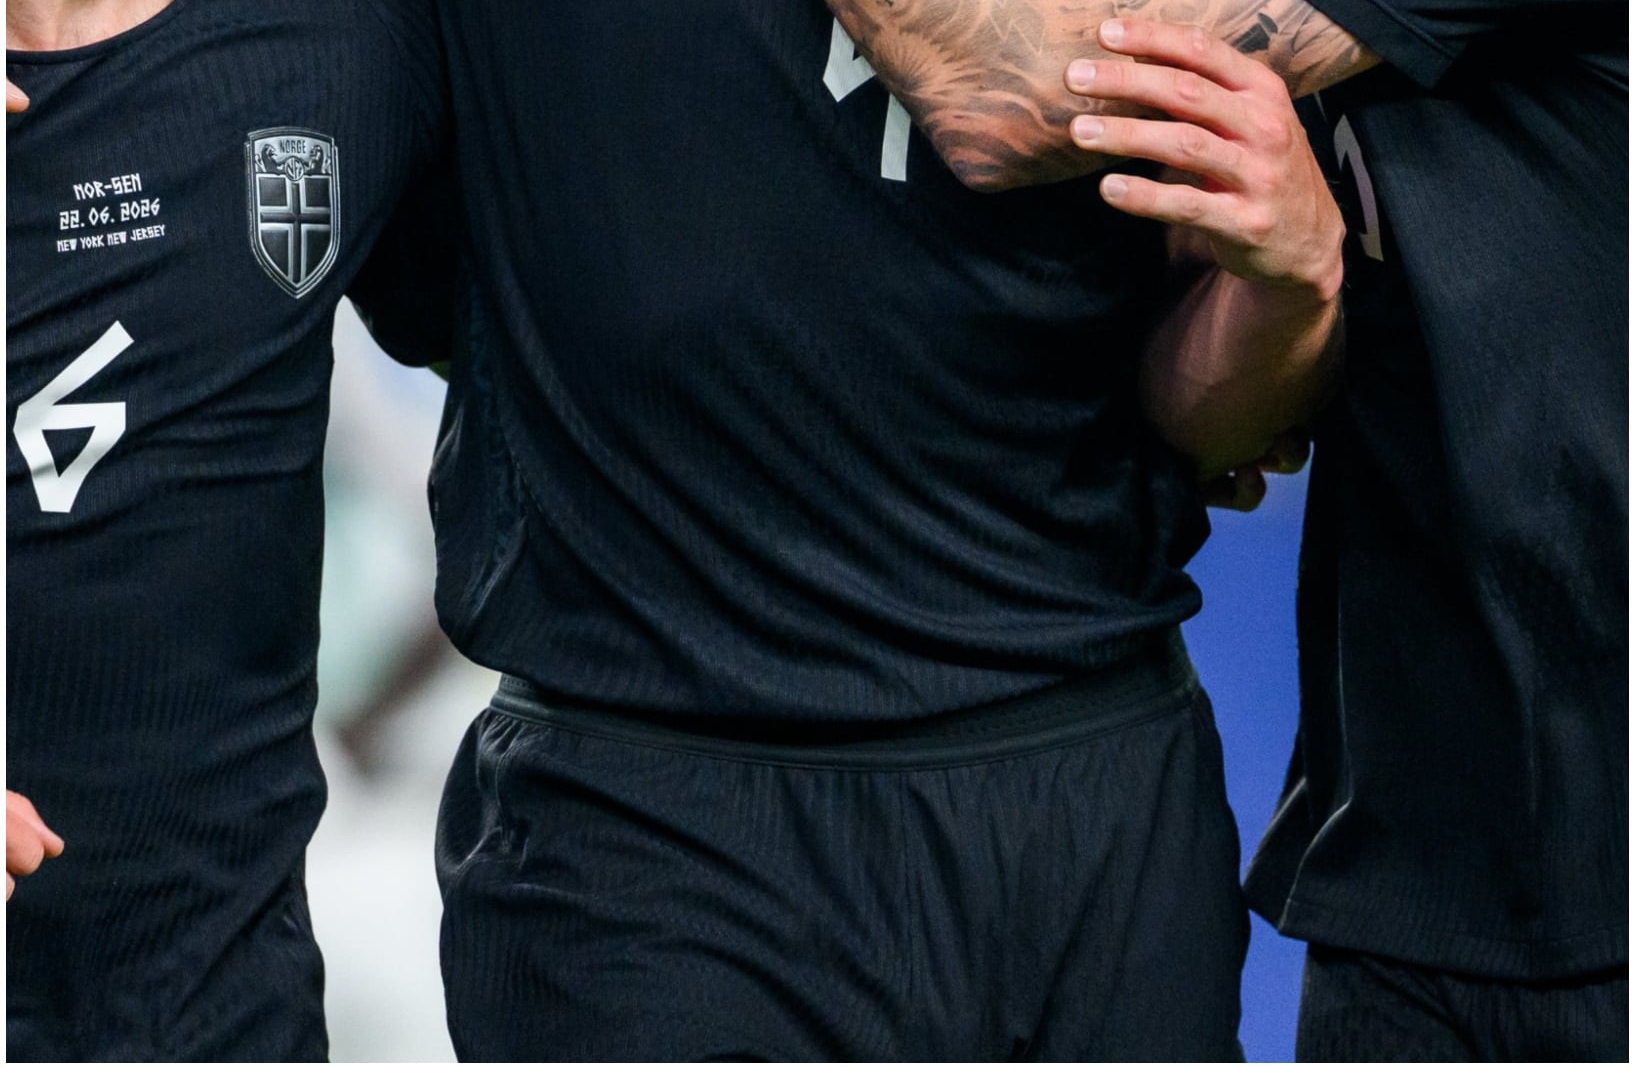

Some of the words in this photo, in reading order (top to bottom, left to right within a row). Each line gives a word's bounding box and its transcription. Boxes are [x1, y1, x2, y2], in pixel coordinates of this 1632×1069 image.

[279, 139, 306, 154] NORGE
[73, 173, 142, 201] NOR-SEN
[56, 238, 77, 252] NEW
[80, 234, 105, 249] YORK
[106, 231, 127, 246] NEW
[130, 224, 165, 241] JERSEY
[13, 319, 135, 513] 6
